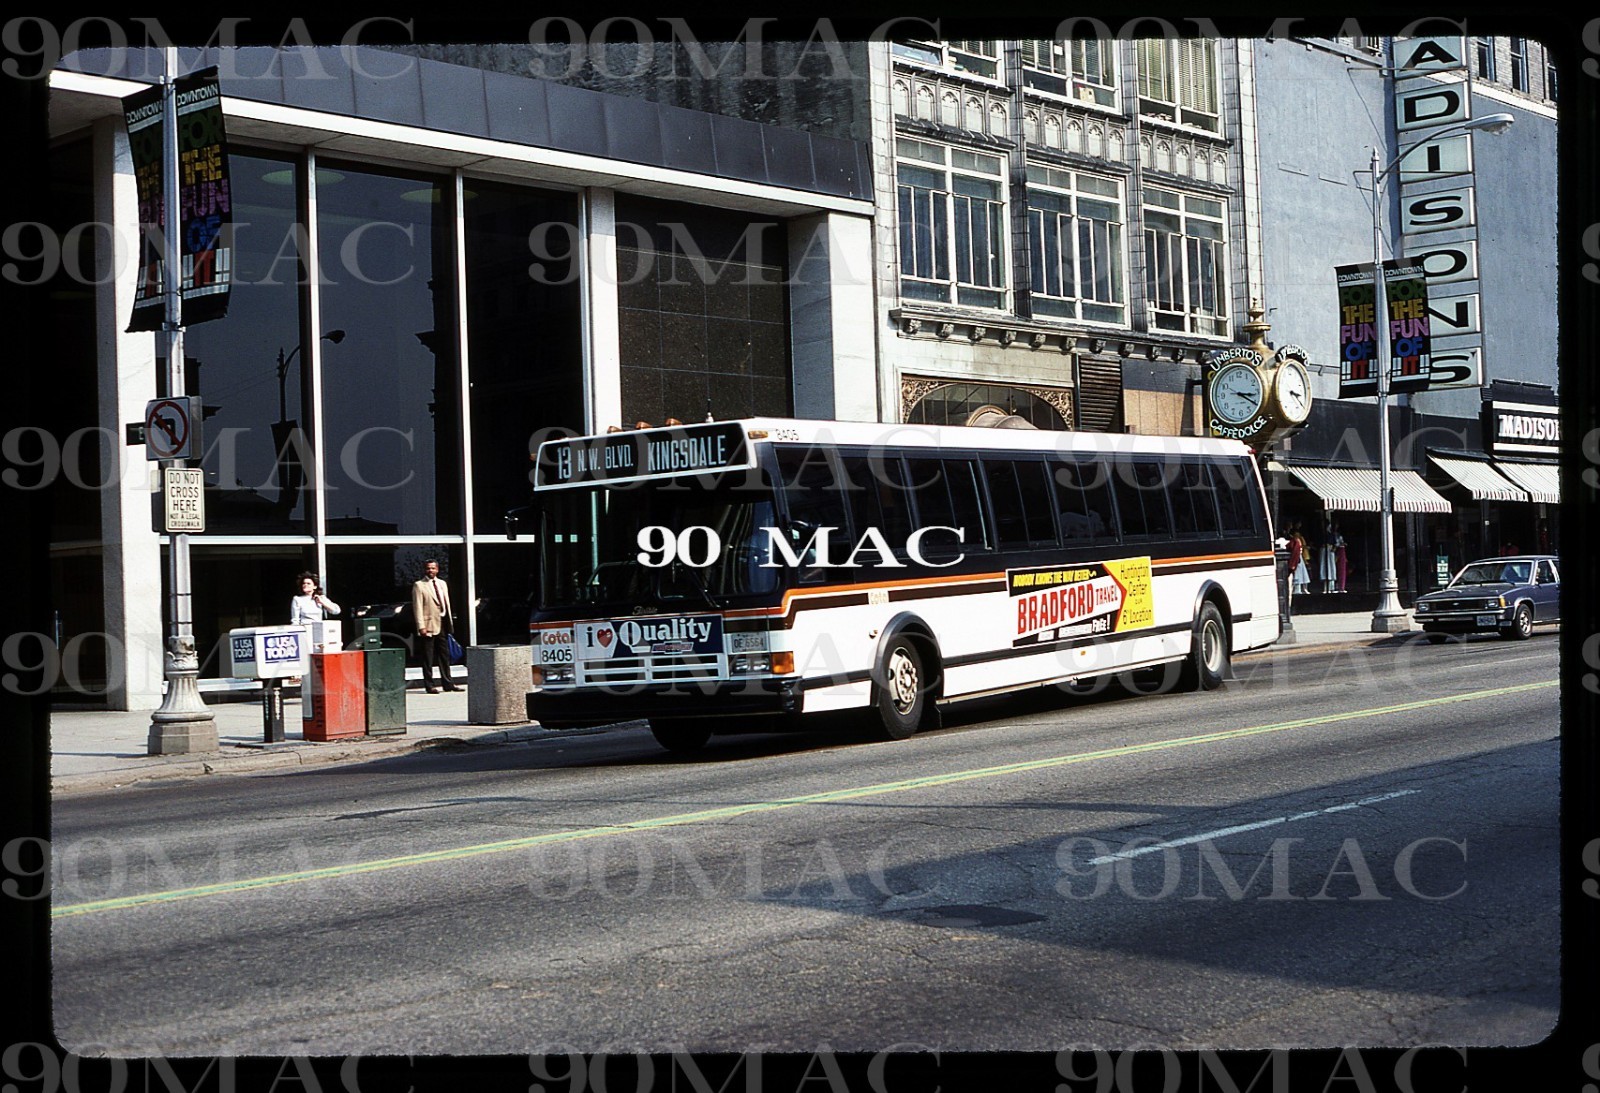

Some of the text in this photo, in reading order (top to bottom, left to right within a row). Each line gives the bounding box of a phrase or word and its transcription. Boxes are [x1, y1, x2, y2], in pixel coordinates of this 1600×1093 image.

[177, 83, 219, 106] DOWNTOWN
[126, 99, 163, 124] DOWNTOWN
[181, 144, 222, 185] THE
[181, 178, 230, 220] FUN
[194, 250, 215, 287] IT
[1338, 271, 1375, 282] DOWNTOWN
[1385, 266, 1424, 277] DOWNTOWN
[1387, 278, 1427, 301] FOR
[1343, 303, 1374, 325] THE
[1391, 298, 1424, 320] THE
[1341, 321, 1377, 344] FUN
[1390, 316, 1430, 340] FUN
[1345, 341, 1373, 361] OF
[1396, 336, 1423, 358] OF
[1210, 347, 1264, 372] UMBERTO'S
[1352, 360, 1368, 379] IT
[1402, 355, 1419, 376] IT
[776, 428, 799, 441] 8405
[557, 446, 572, 480] 13
[604, 444, 634, 470] BLVD.
[648, 434, 727, 471] KINGSDALE
[169, 473, 200, 485] DO NOT
[170, 486, 200, 499] CROSS
[173, 500, 197, 511] HERE
[1017, 583, 1094, 635] BRADFORD
[1096, 585, 1118, 606] TRAVEL
[1092, 614, 1111, 633] FREE!
[239, 639, 254, 648] USA
[276, 635, 298, 648] USA
[619, 618, 712, 654] Quality
[234, 647, 254, 659] TODAY
[265, 645, 299, 659] TODAY
[541, 649, 573, 663] 8405
